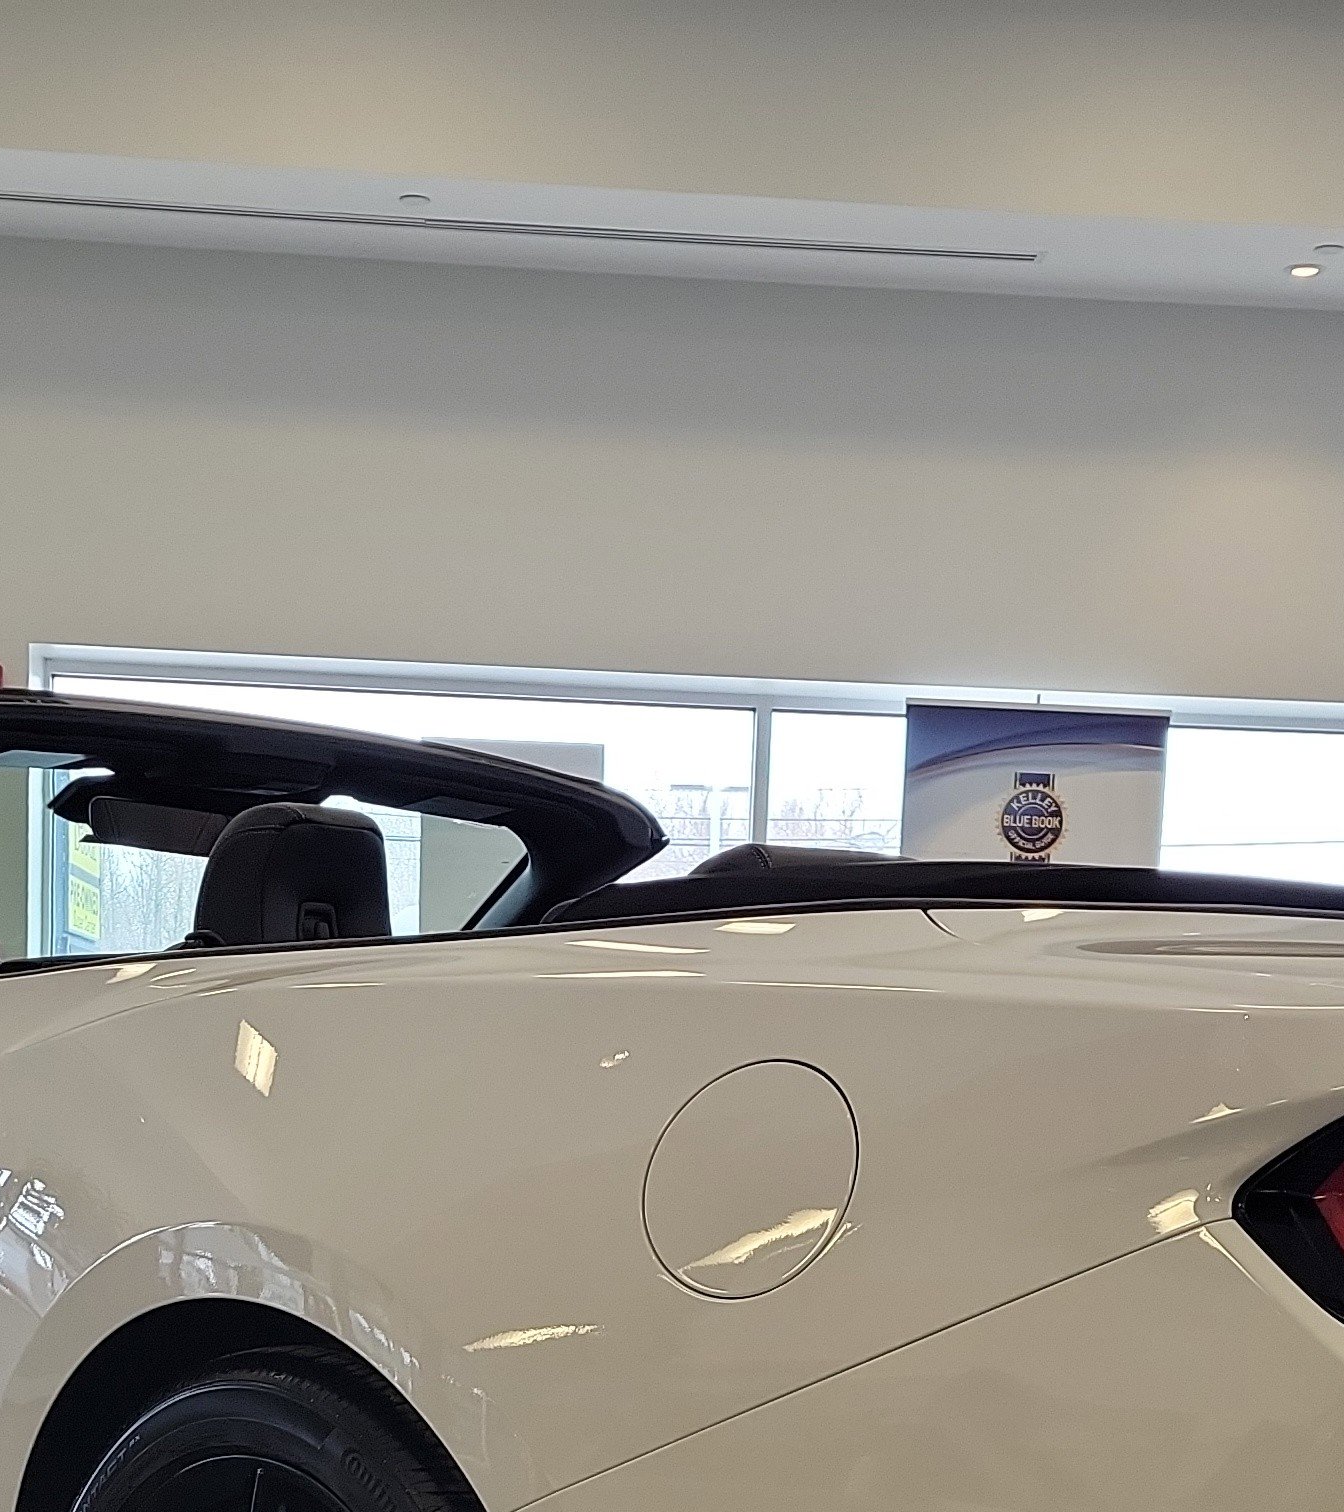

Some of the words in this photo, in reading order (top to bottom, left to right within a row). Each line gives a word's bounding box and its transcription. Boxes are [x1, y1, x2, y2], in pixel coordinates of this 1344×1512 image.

[1010, 792, 1058, 812] KELLEY
[1003, 814, 1031, 828] BLUE
[1032, 816, 1061, 829] BOOK
